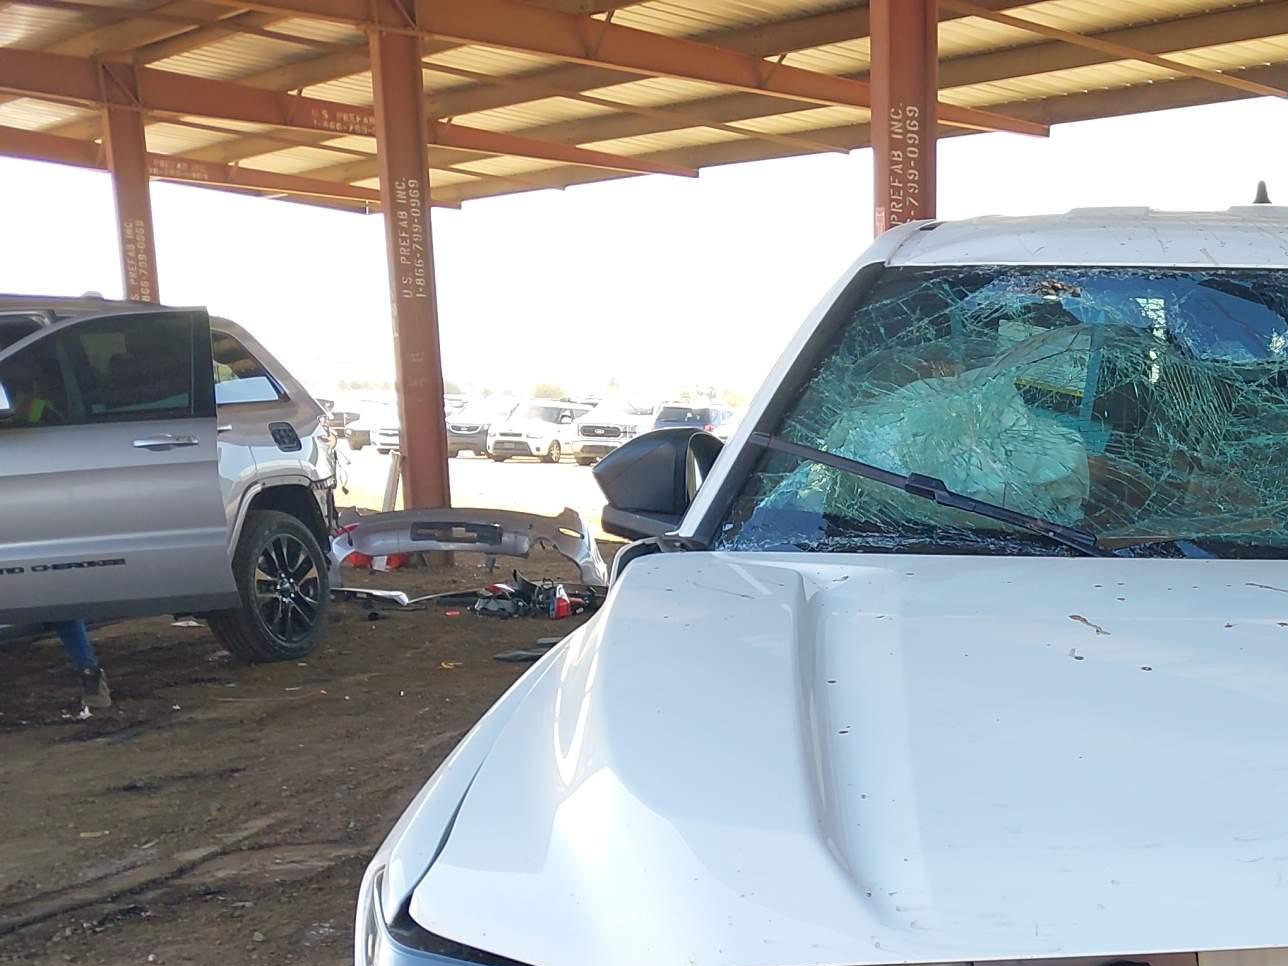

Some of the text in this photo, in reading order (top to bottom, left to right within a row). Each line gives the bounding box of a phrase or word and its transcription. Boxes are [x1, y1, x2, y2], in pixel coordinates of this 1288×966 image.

[395, 177, 408, 203] INC.
[890, 149, 904, 225] PREFAB
[906, 105, 919, 223] -799-0969
[398, 210, 411, 264] PREFAB
[408, 179, 427, 298] 1-866-799-0969
